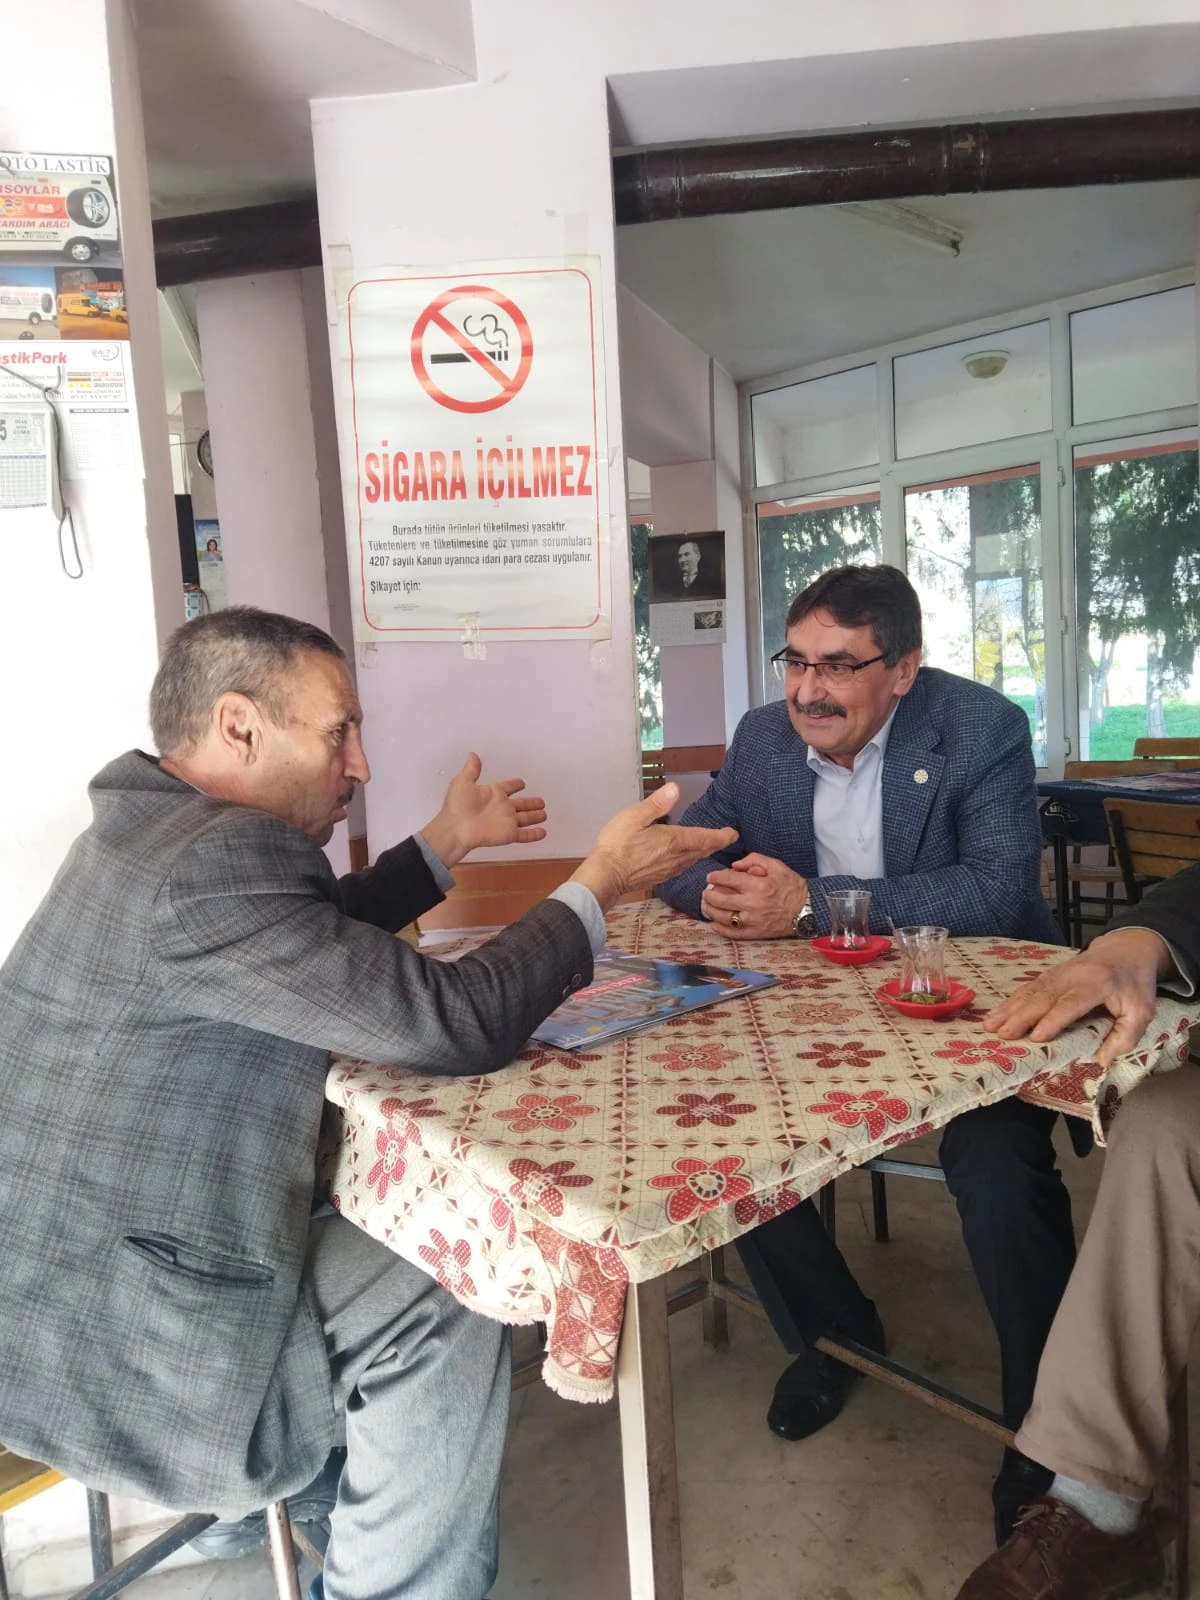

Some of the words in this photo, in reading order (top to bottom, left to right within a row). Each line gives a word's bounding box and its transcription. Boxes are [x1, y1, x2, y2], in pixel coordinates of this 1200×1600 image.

[43, 157, 108, 173] LASTİK
[0, 351, 68, 365] stikPark
[364, 439, 468, 503] SİGARA
[475, 434, 593, 508] İÇİLMEZ
[392, 524, 422, 536] Burada
[424, 523, 446, 535] tütün
[448, 522, 481, 534] ürünleri
[483, 521, 530, 533] tüketilmesi
[531, 521, 567, 535] yasaktır.
[368, 540, 417, 551] Tüketenlere
[420, 541, 431, 550] ve
[433, 537, 489, 550] tüketilmesine
[492, 538, 508, 551] göz
[510, 538, 539, 550] yuman
[542, 535, 593, 548] sorumlulara
[369, 556, 390, 567] 4207
[392, 556, 415, 569] sayılı
[416, 555, 443, 567] Kanun
[444, 556, 480, 567] uyarınca
[503, 553, 522, 566] para
[524, 553, 551, 564] cezası
[552, 551, 593, 565] uygulanır.
[370, 580, 402, 595] Şikayet
[403, 580, 421, 594] için:
